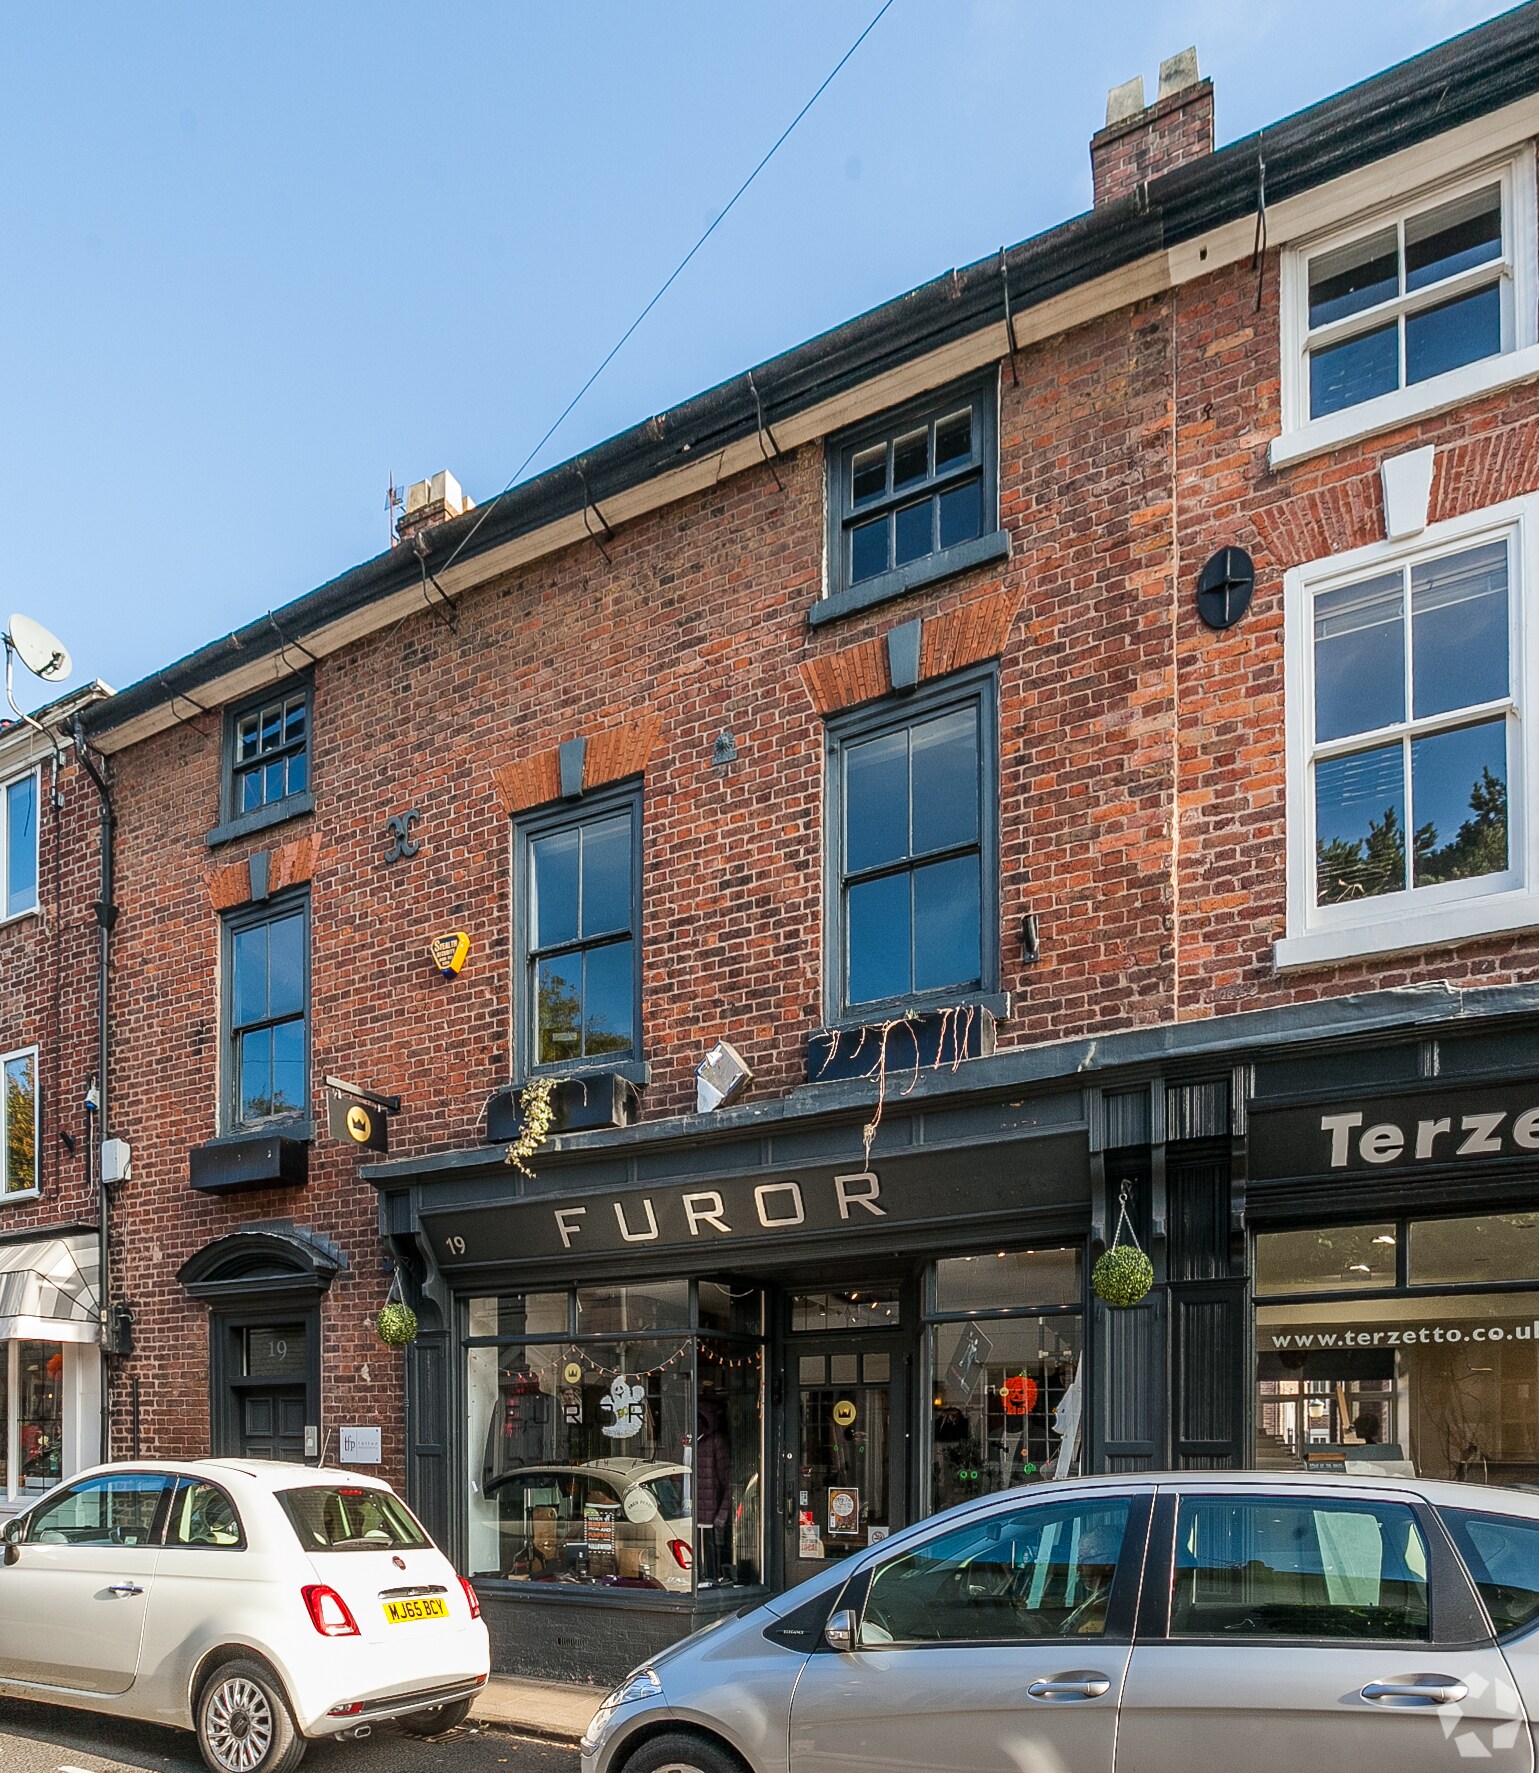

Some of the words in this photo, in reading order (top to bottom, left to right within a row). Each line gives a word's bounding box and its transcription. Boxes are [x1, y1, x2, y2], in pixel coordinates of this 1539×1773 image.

[553, 1171, 888, 1249] FUROR
[445, 1235, 467, 1256] 19
[268, 1340, 288, 1361] 19
[388, 1601, 423, 1621] MJ65
[422, 1599, 444, 1616] BCY
